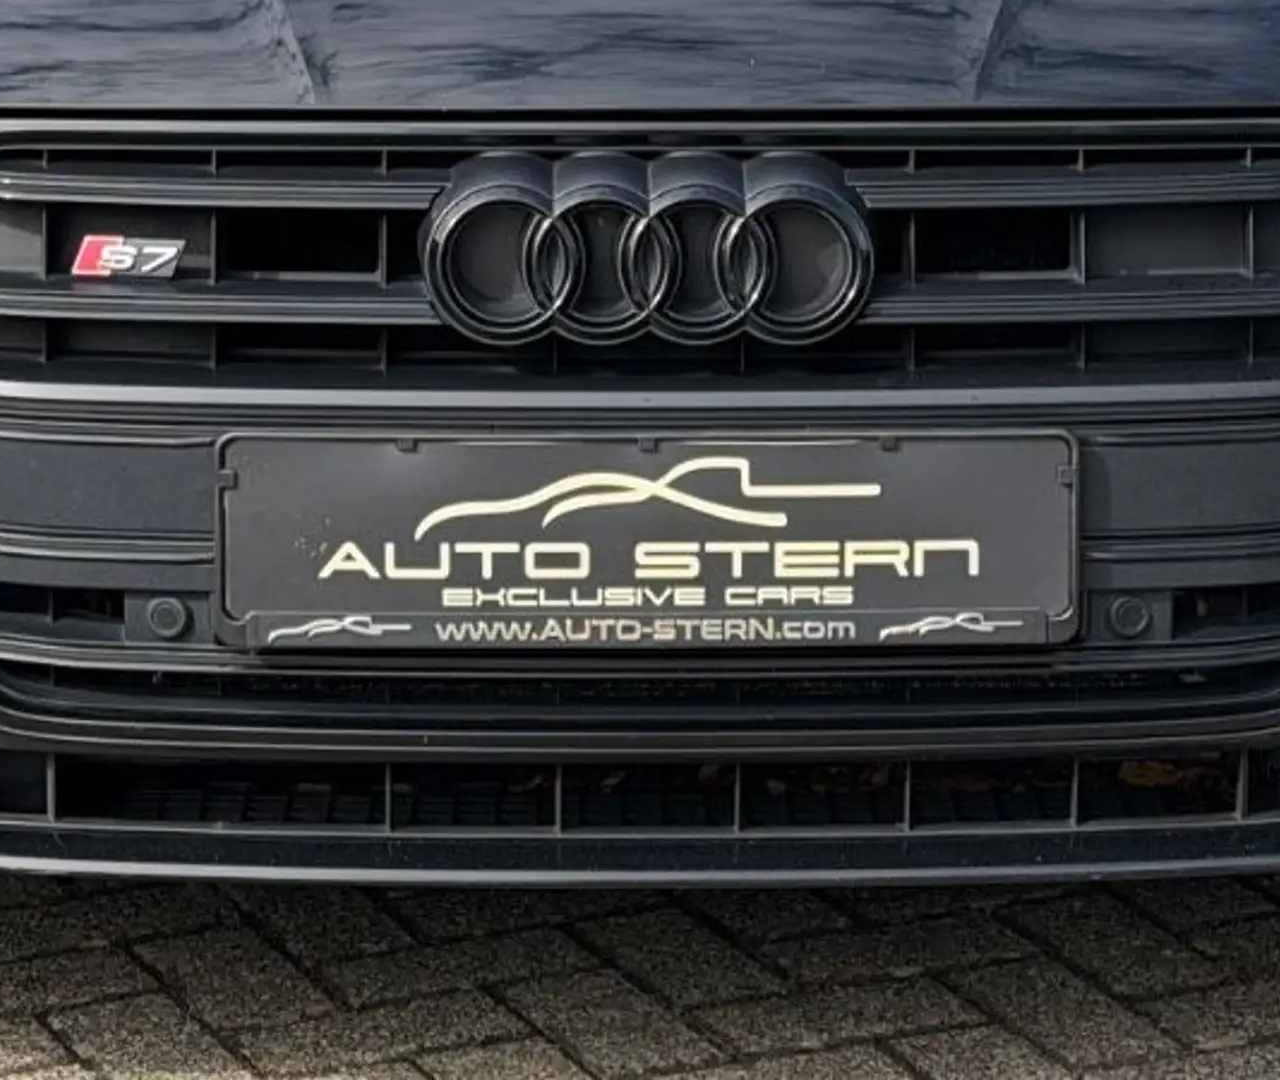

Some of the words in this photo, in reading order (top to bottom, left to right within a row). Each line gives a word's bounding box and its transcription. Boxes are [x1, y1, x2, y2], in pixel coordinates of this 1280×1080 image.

[100, 244, 179, 273] S7
[317, 541, 590, 580] AUTO
[634, 539, 980, 579] STERN
[441, 587, 706, 607] EXCLUSIVE
[724, 585, 854, 606] CARS
